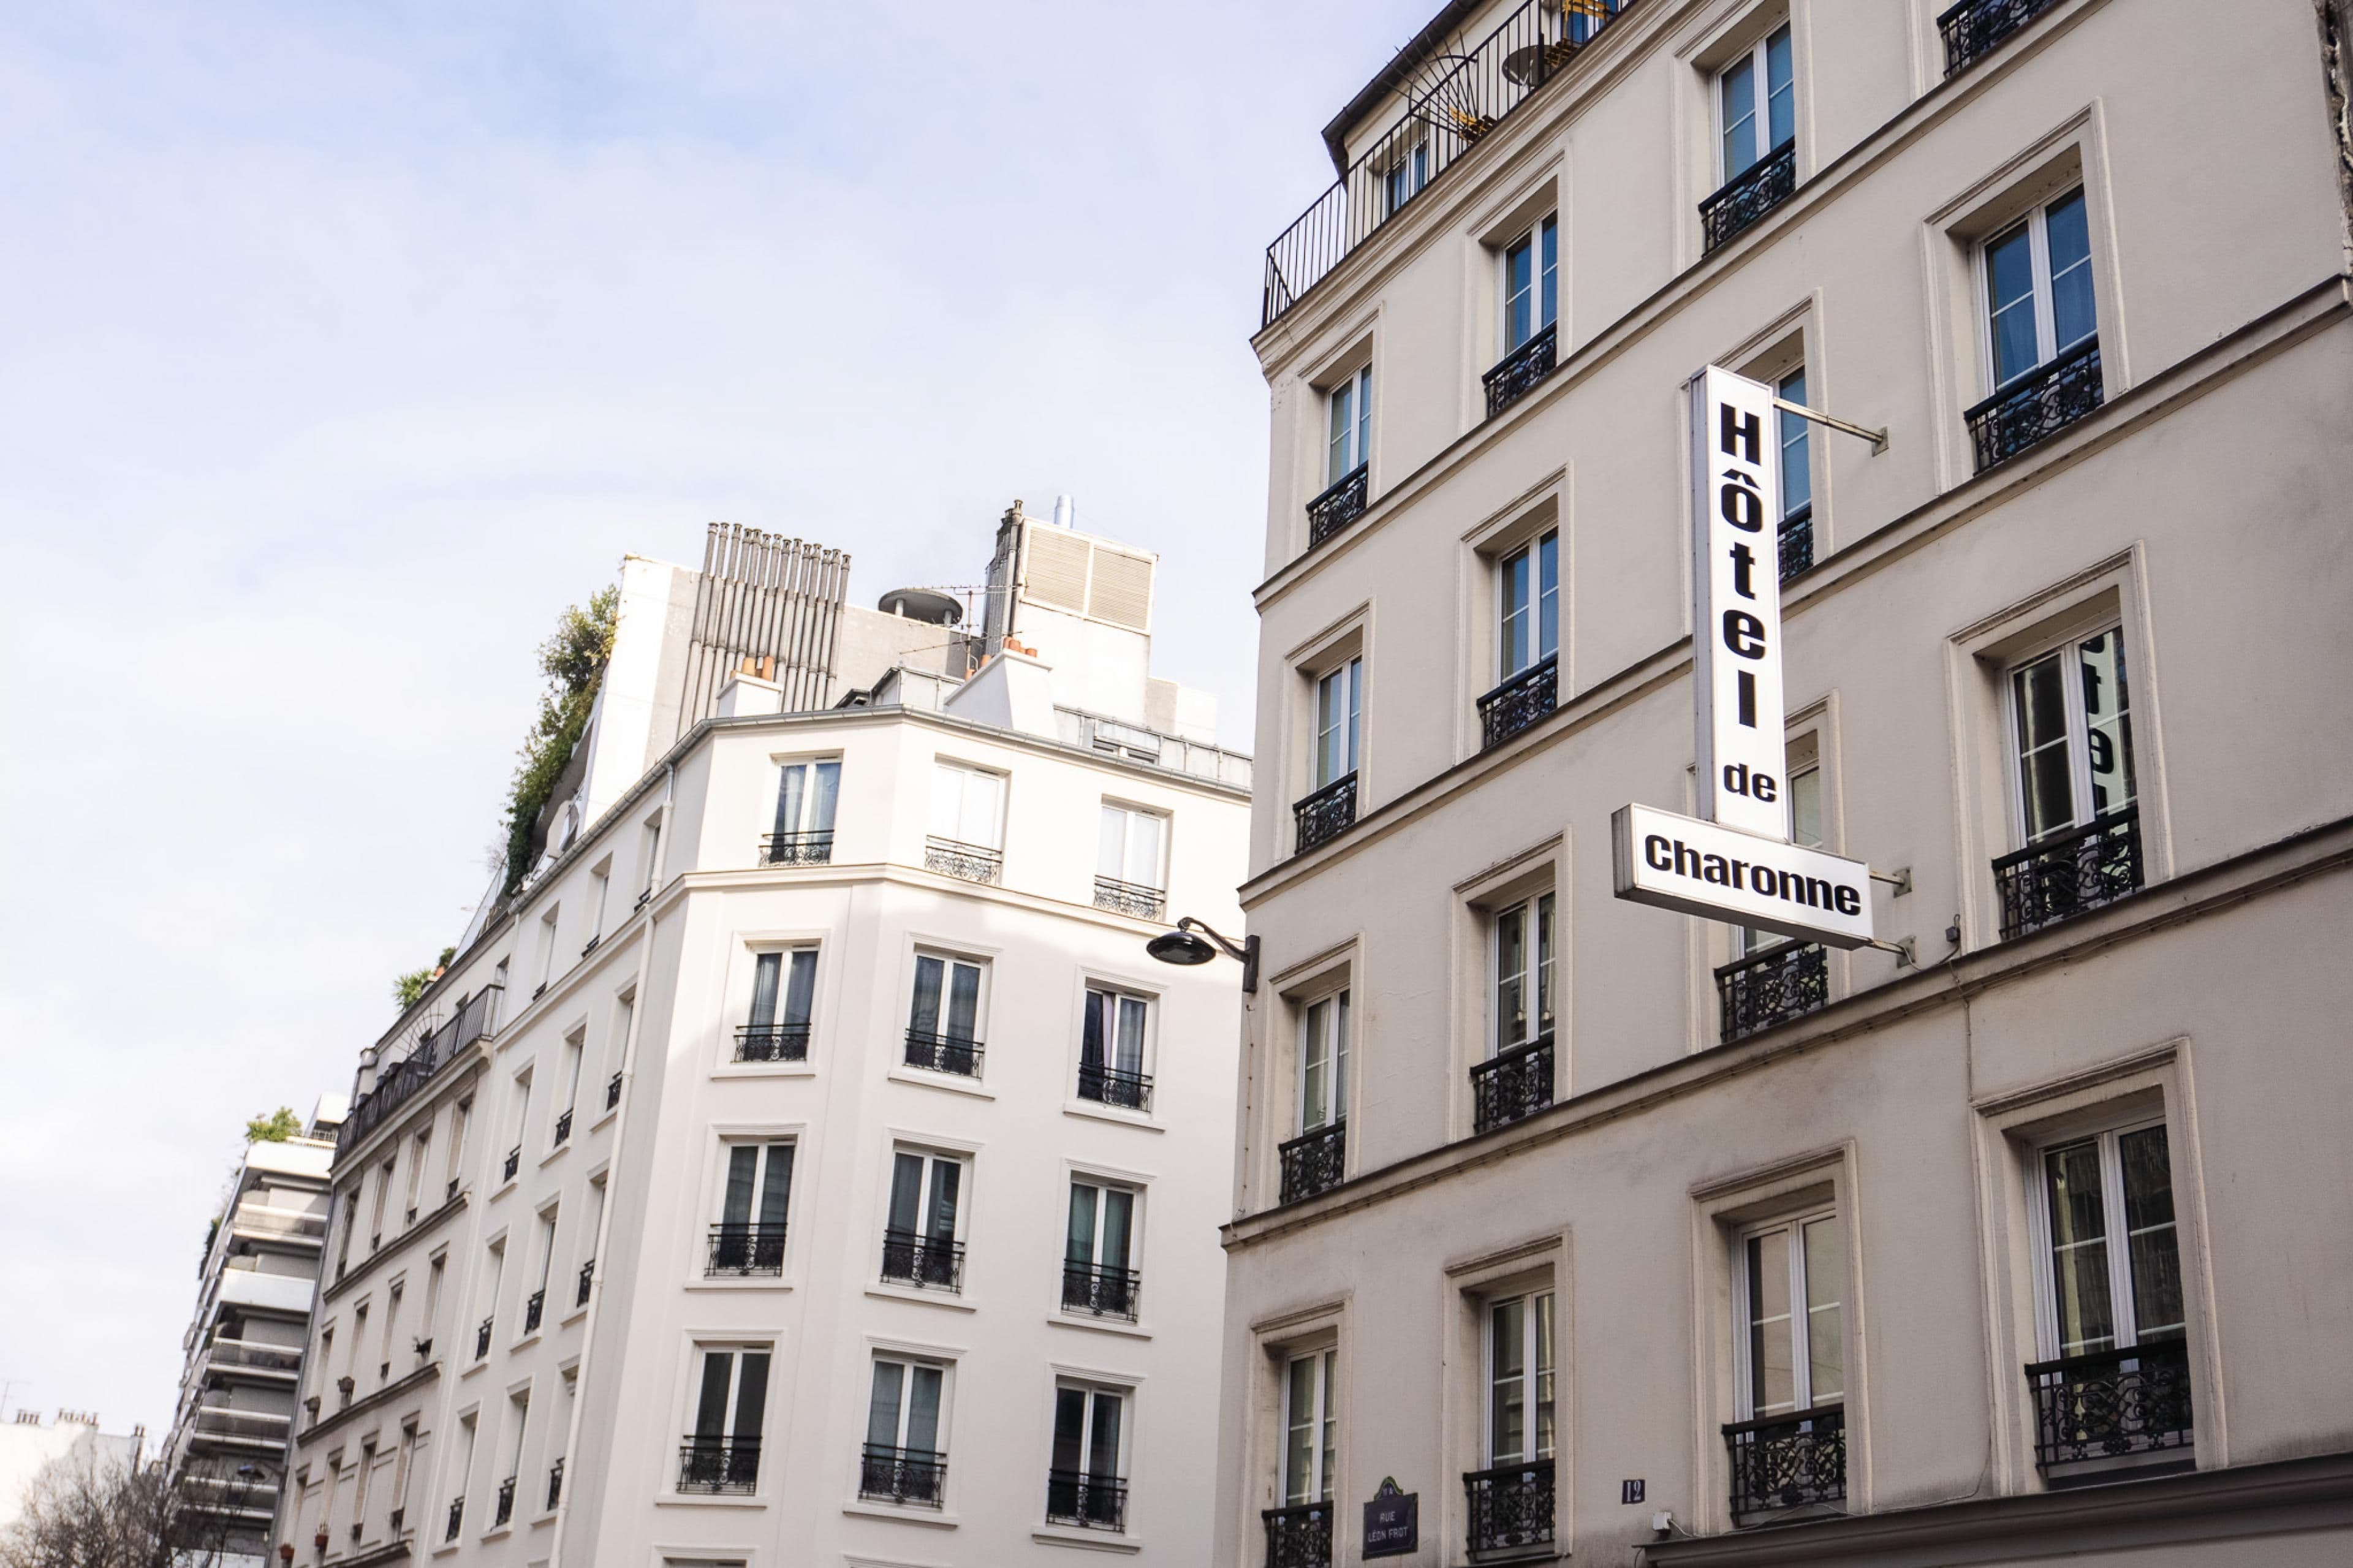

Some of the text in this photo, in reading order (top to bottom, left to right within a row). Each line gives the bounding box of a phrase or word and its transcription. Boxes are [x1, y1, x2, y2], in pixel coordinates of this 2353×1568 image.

[1721, 401, 1765, 729] Hôtel
[1723, 763, 1776, 803] de
[1645, 835, 1861, 916] Charonne
[1627, 1480, 1641, 1501] 12
[1379, 1511, 1396, 1523] RUE
